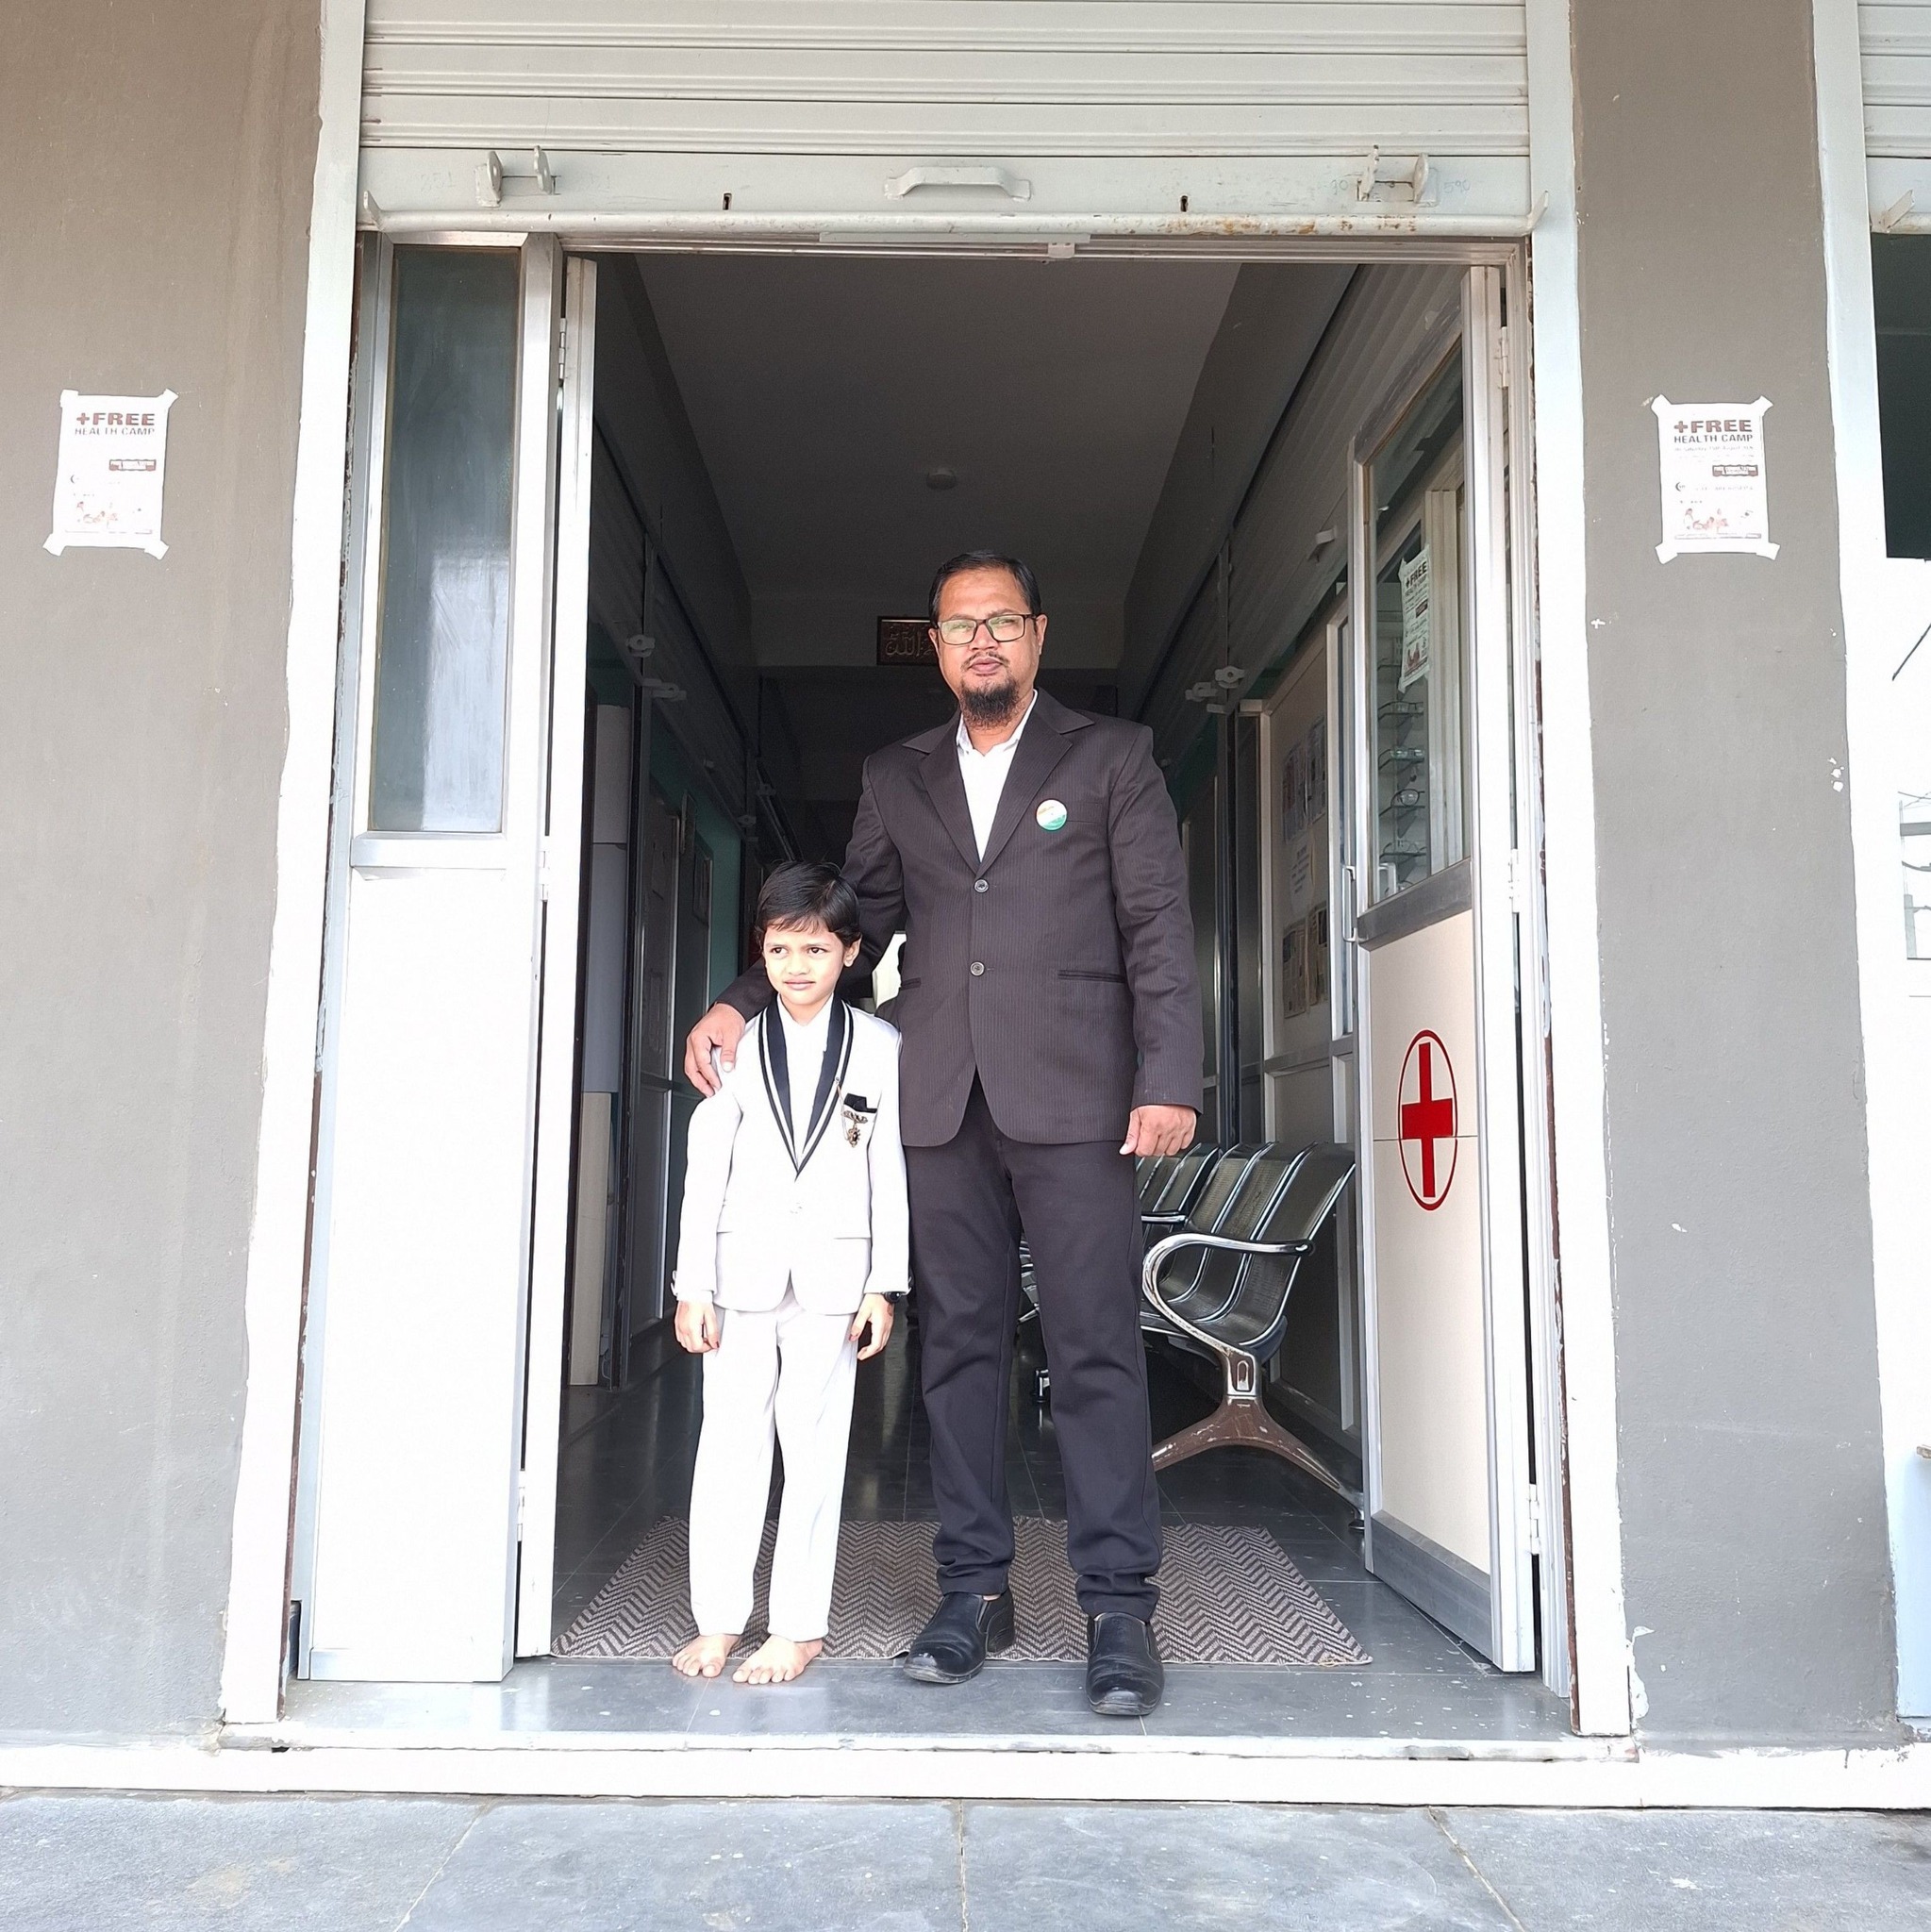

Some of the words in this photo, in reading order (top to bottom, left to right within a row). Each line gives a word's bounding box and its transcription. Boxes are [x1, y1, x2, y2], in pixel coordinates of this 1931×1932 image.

[75, 427, 118, 436] HEALTH
[121, 427, 156, 436] CAMP
[1673, 434, 1718, 444] HEALTH
[1721, 434, 1754, 442] CAMP
